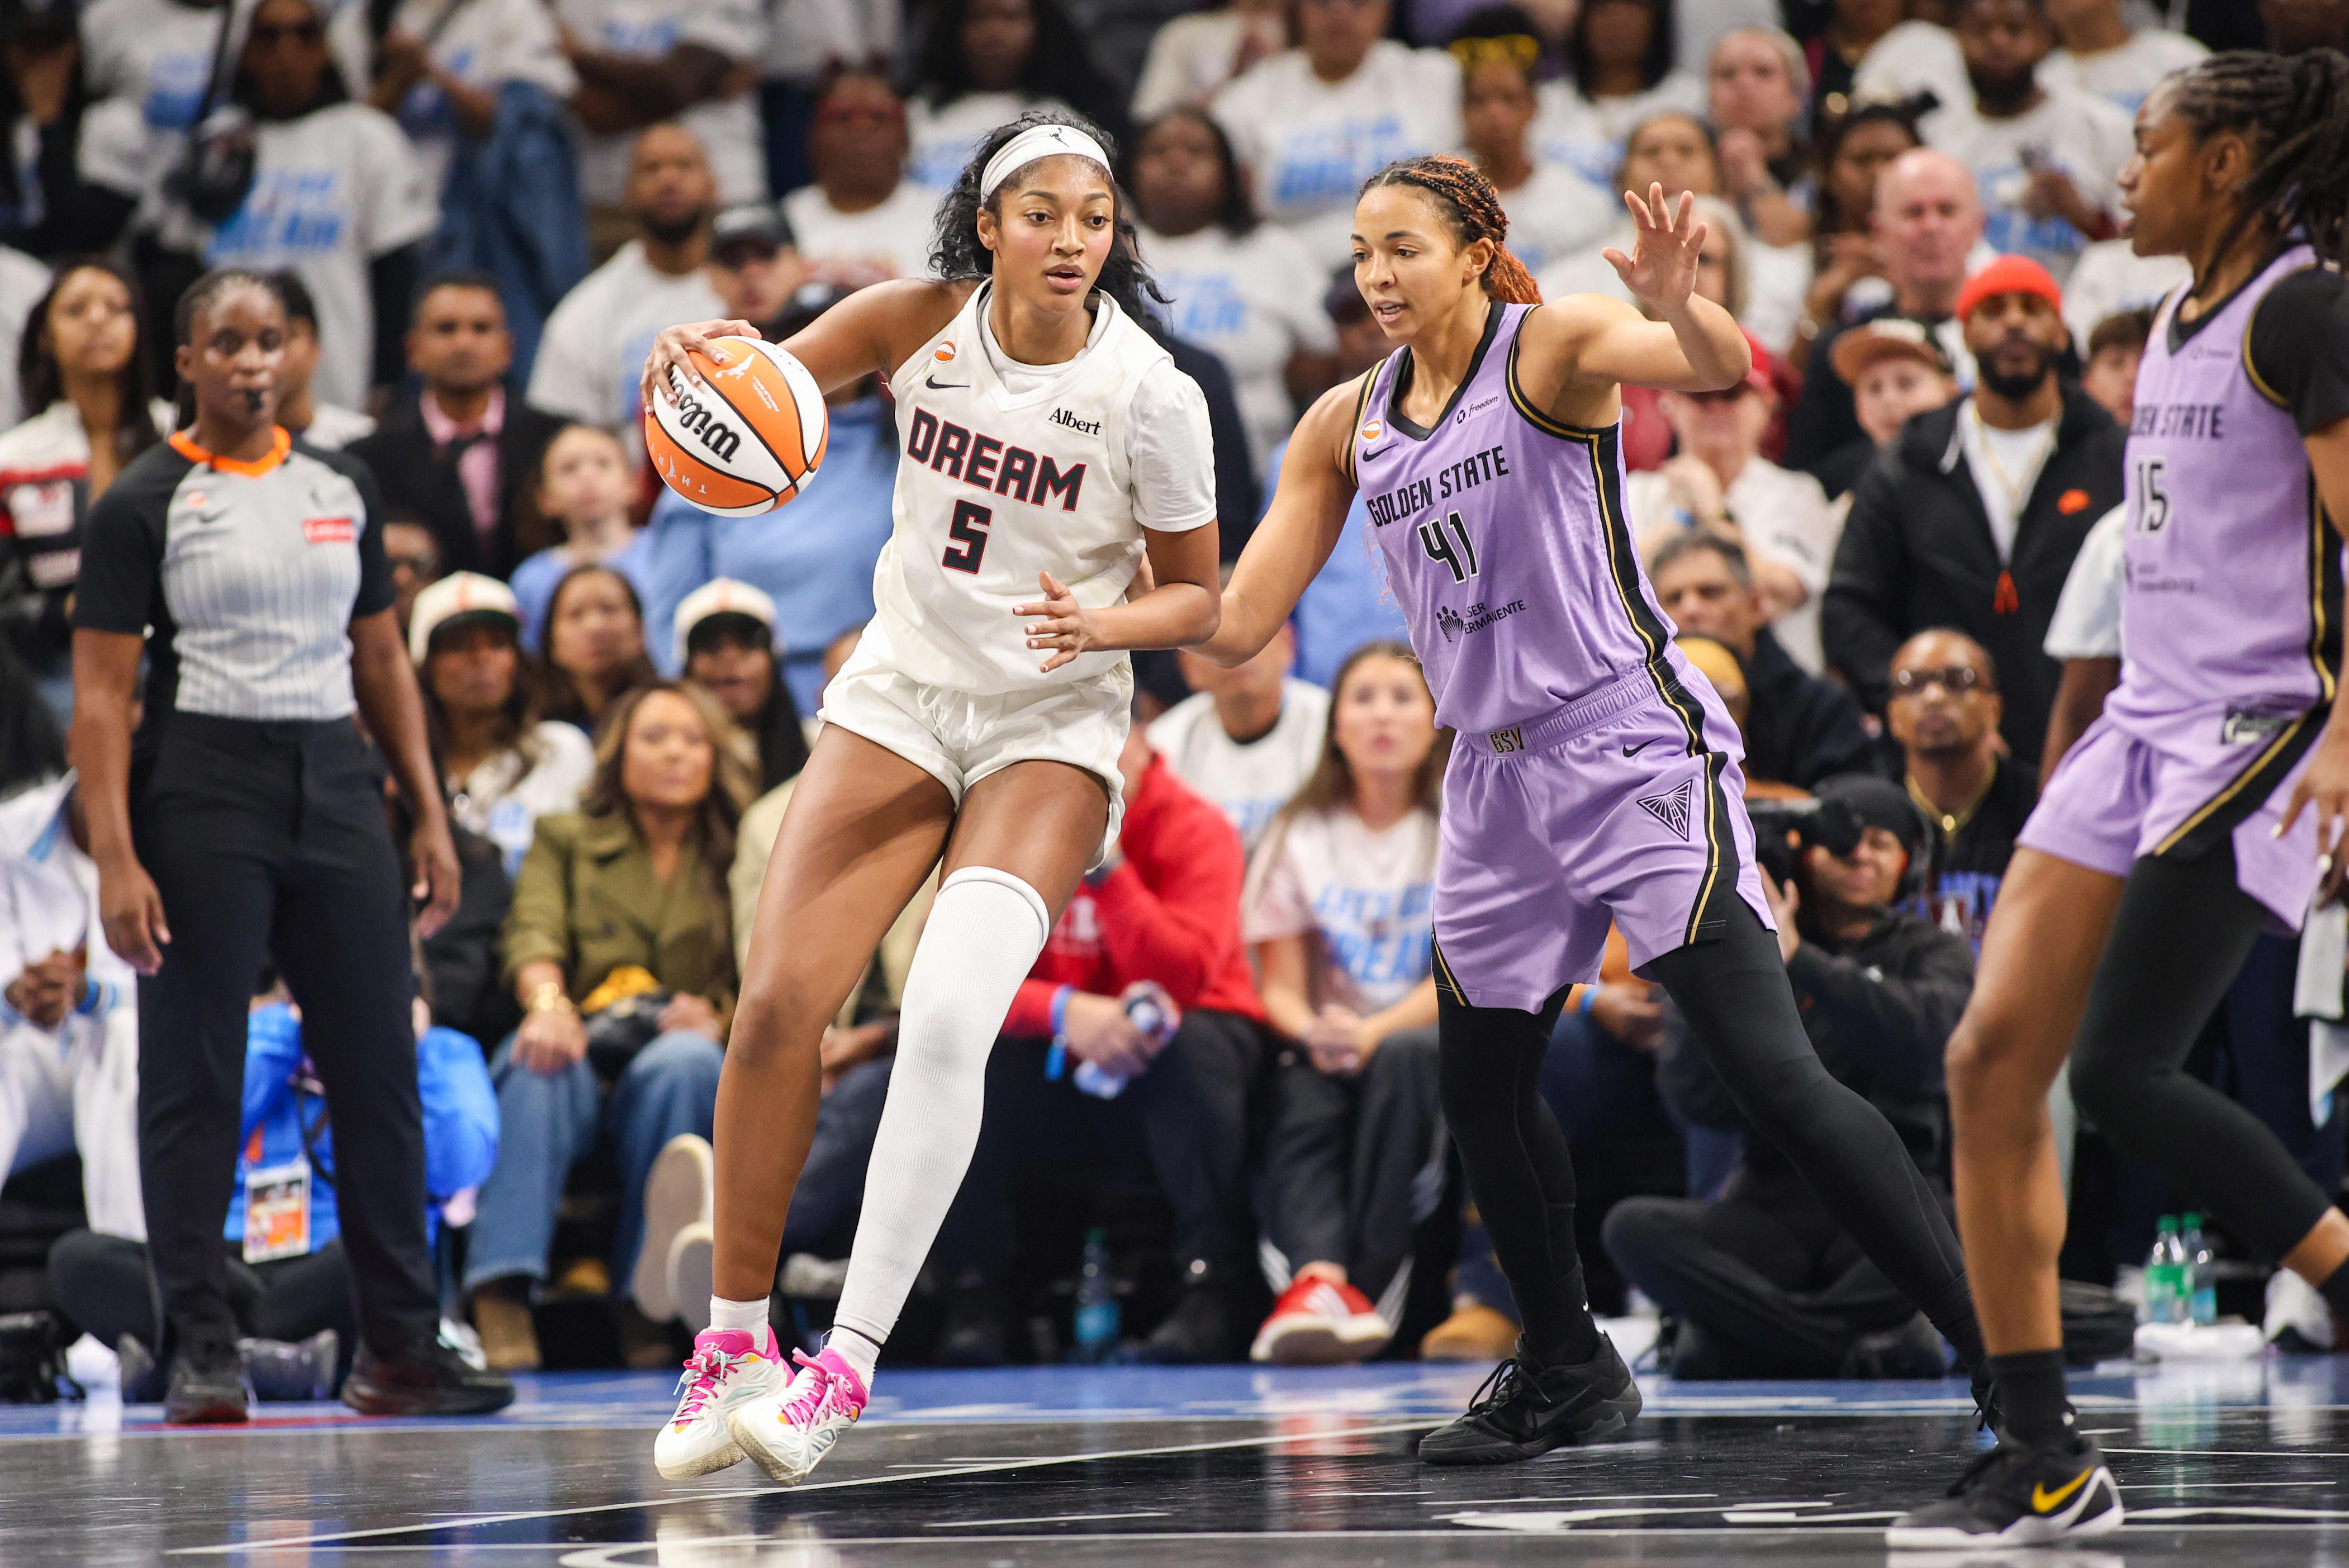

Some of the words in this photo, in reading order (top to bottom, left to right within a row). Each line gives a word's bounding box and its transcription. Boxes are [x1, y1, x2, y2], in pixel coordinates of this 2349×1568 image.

[1048, 407, 1101, 435] Albert
[1469, 396, 1498, 417] freedom
[907, 406, 1086, 512] DREAM
[1366, 477, 1432, 527] GOLDEN
[1440, 445, 1509, 499] STATE
[2135, 461, 2168, 533] 15
[942, 499, 992, 574] 5
[1417, 510, 1479, 585] 41
[1464, 600, 1526, 634] ERMANENTE
[1466, 603, 1486, 618] SER
[1488, 727, 1525, 753] GSV
